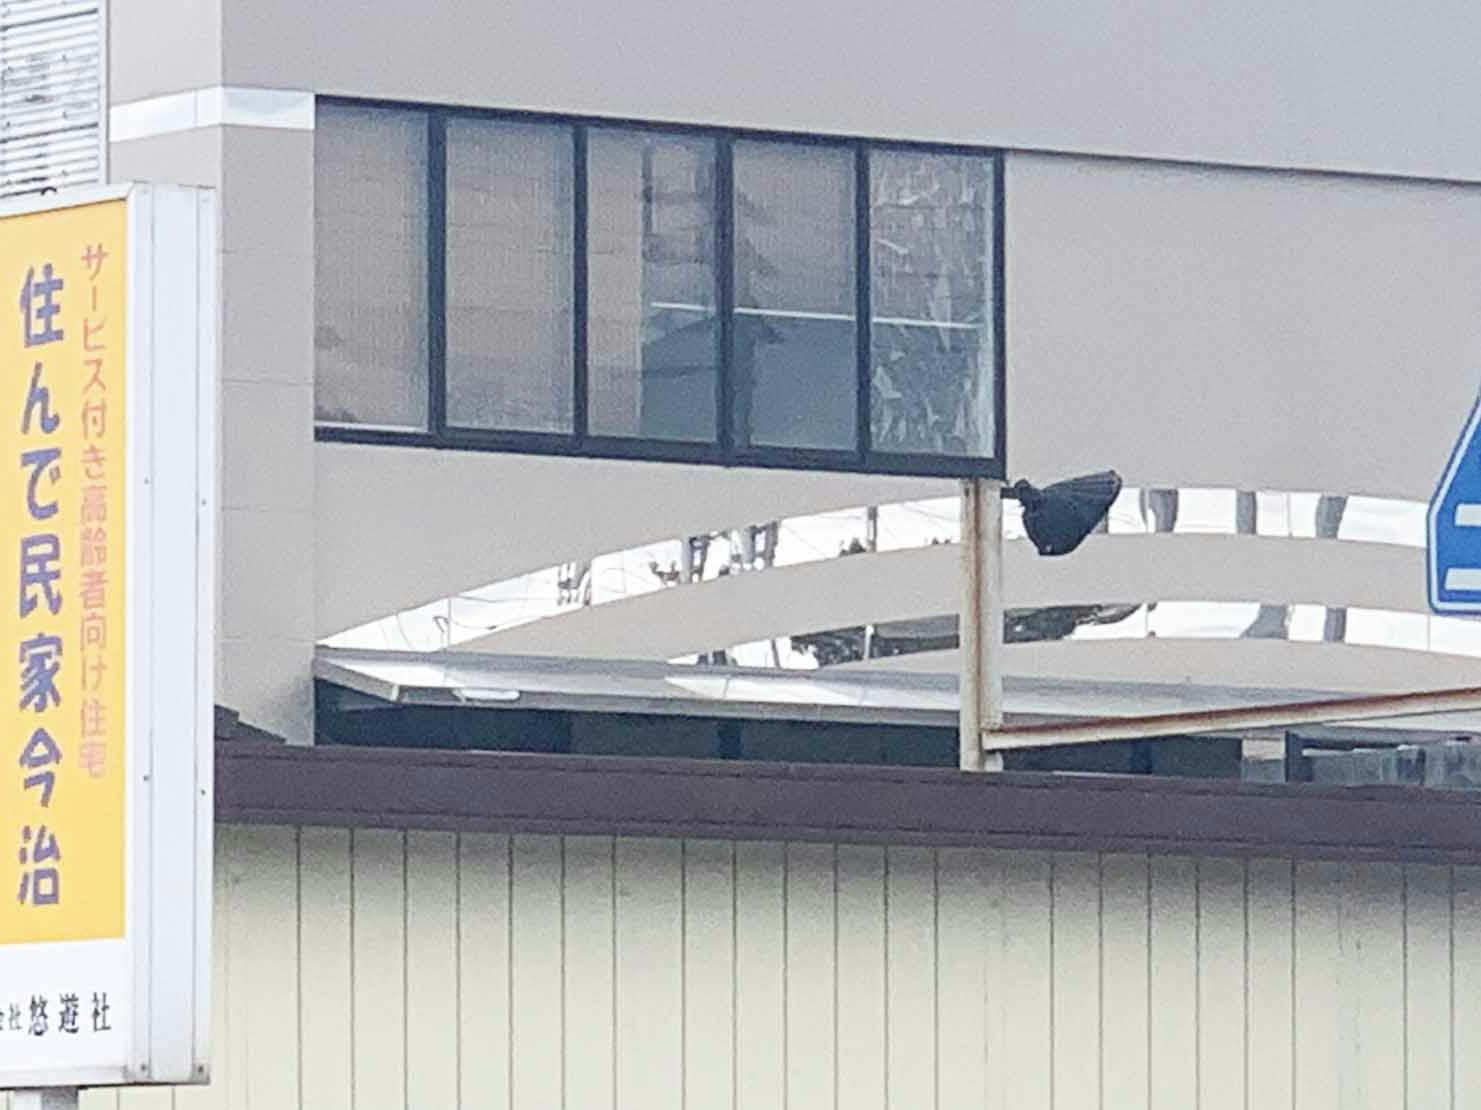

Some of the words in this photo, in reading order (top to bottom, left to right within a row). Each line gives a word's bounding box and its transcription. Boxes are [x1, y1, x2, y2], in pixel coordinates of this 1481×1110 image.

[17, 263, 64, 906] 住んで民家今治
